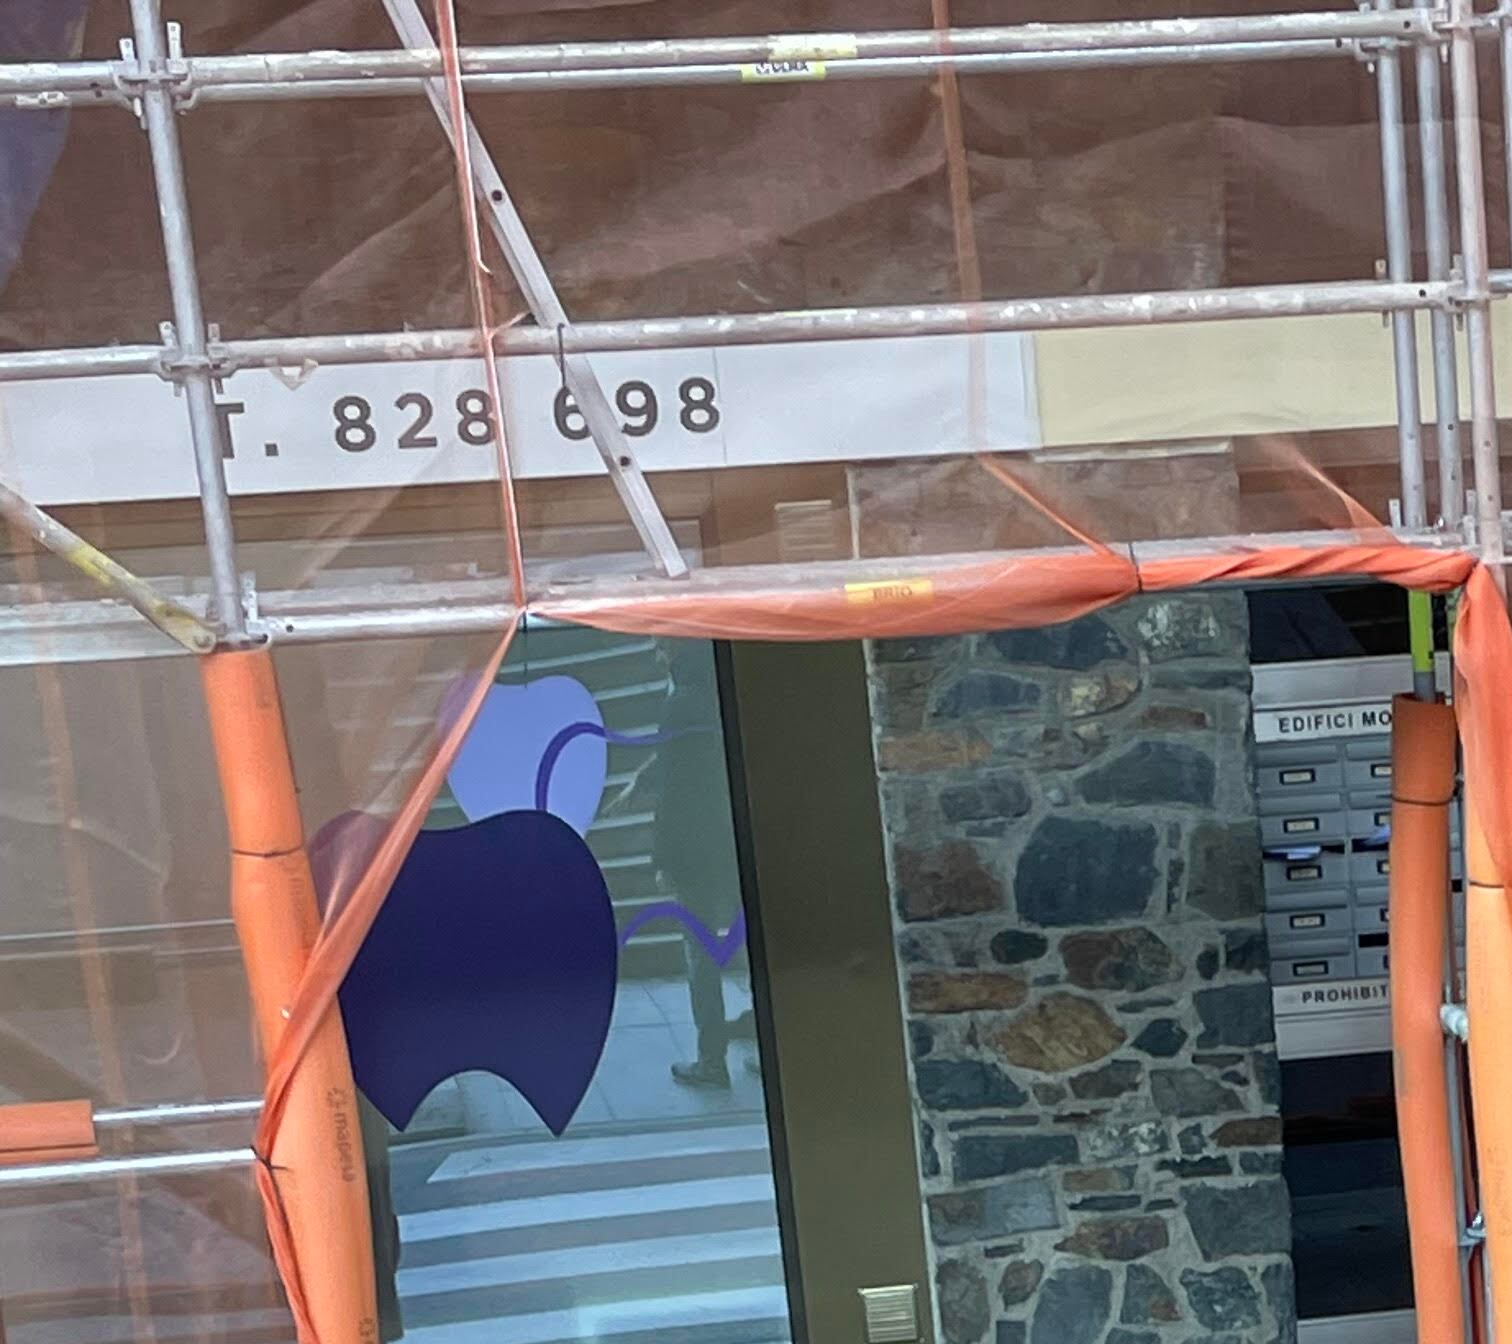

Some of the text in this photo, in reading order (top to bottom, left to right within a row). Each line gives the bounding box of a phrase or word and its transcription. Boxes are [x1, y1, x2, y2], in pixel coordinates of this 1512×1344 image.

[332, 387, 497, 453] 828
[552, 376, 720, 441] 698
[1278, 712, 1354, 734] EDIFICI
